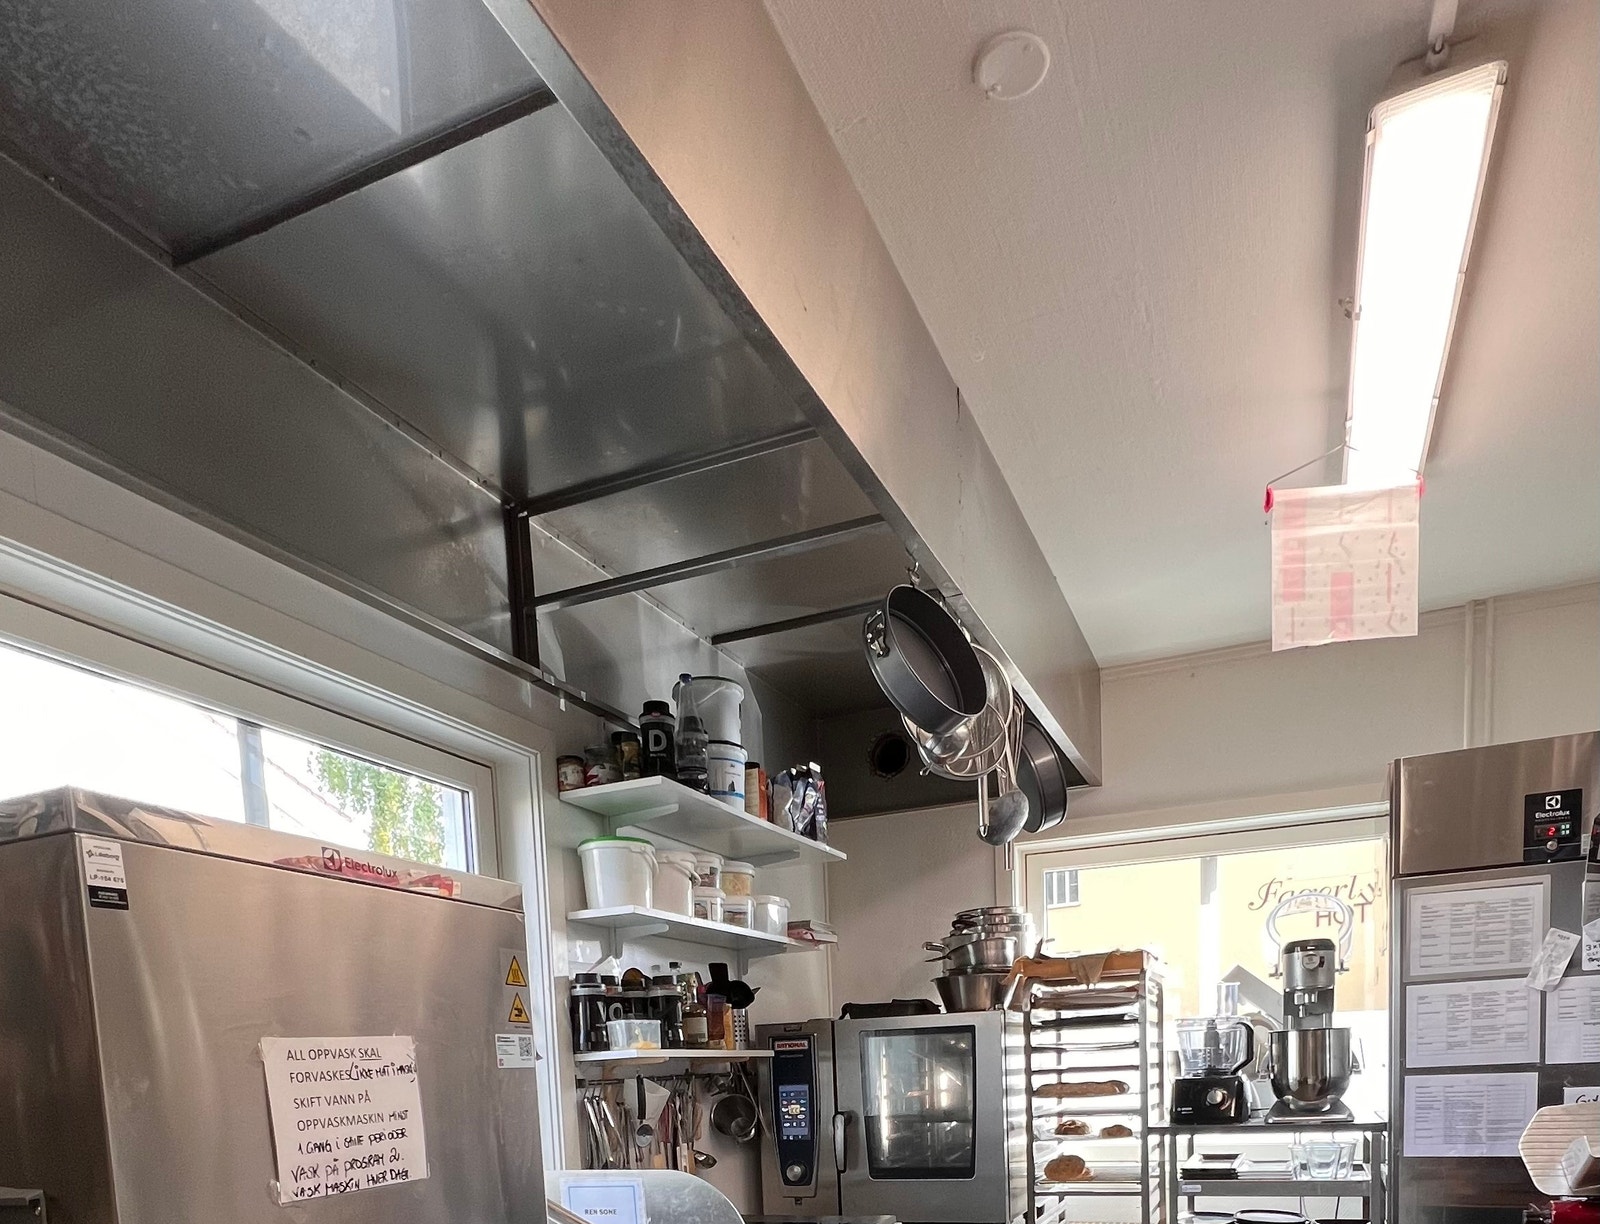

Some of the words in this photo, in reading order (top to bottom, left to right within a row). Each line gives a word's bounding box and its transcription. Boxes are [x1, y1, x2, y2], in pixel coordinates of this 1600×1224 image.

[1535, 810, 1570, 819] Electrolux
[344, 857, 398, 878] Electrolux
[287, 1050, 306, 1061] ALL
[308, 1048, 357, 1061] OPPVASK
[358, 1047, 382, 1060] SKAL
[289, 1070, 351, 1083] FORVASKES
[293, 1096, 322, 1109] SKIFT
[324, 1093, 356, 1107] VANN
[358, 1089, 371, 1103] PÅ
[297, 1112, 384, 1132] OPPVASKMASKIN
[291, 1163, 320, 1183] VASK
[292, 1183, 321, 1197] VASK
[584, 1208, 598, 1216] REN
